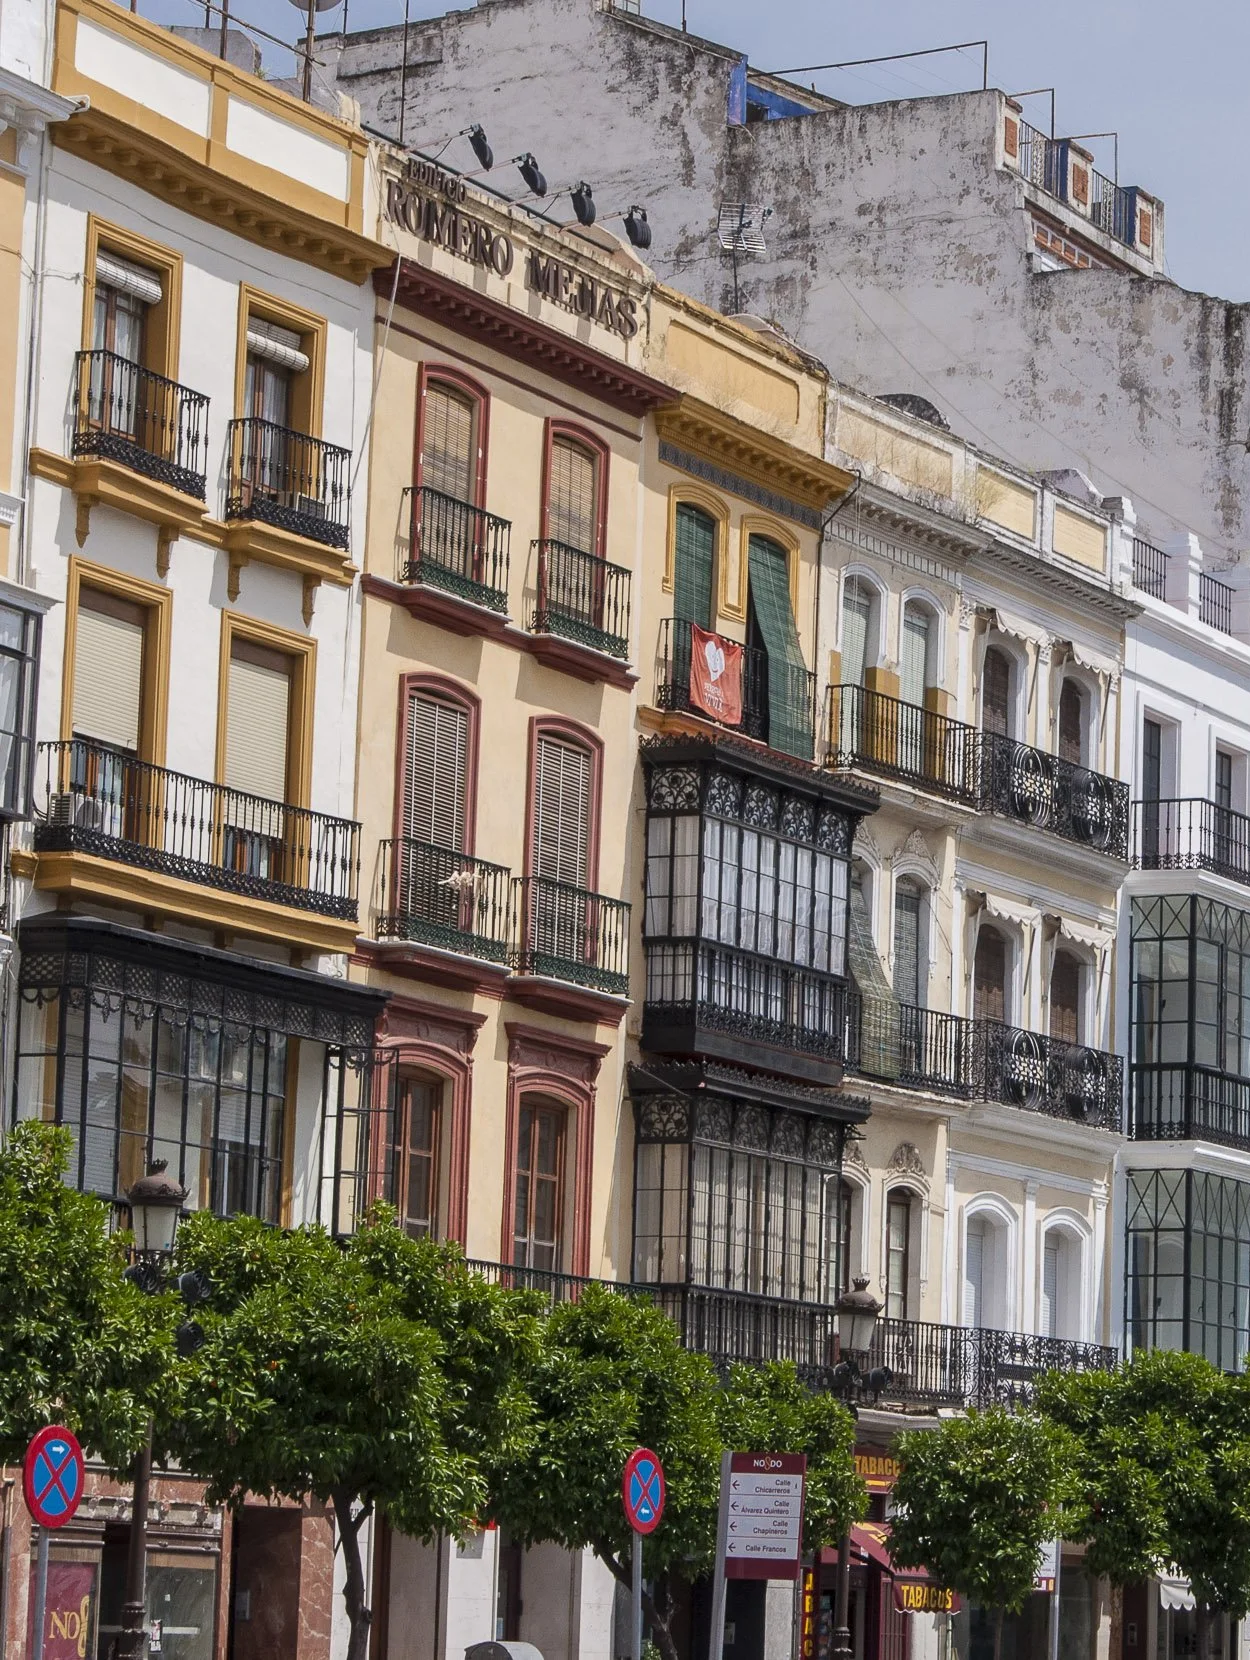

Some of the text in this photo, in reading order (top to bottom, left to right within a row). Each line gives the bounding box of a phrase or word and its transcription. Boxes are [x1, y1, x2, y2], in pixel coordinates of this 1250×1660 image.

[386, 177, 515, 280] ROMERO
[775, 1479, 791, 1487] Calle
[755, 1486, 791, 1494] Chicarreros
[774, 1500, 790, 1508] Calle
[741, 1506, 790, 1515] Álvarez Quintero
[772, 1520, 789, 1528] Calle
[753, 1527, 788, 1536] Chapineros
[745, 1544, 787, 1553] Calle Francos
[901, 1585, 953, 1609] TABACOS
